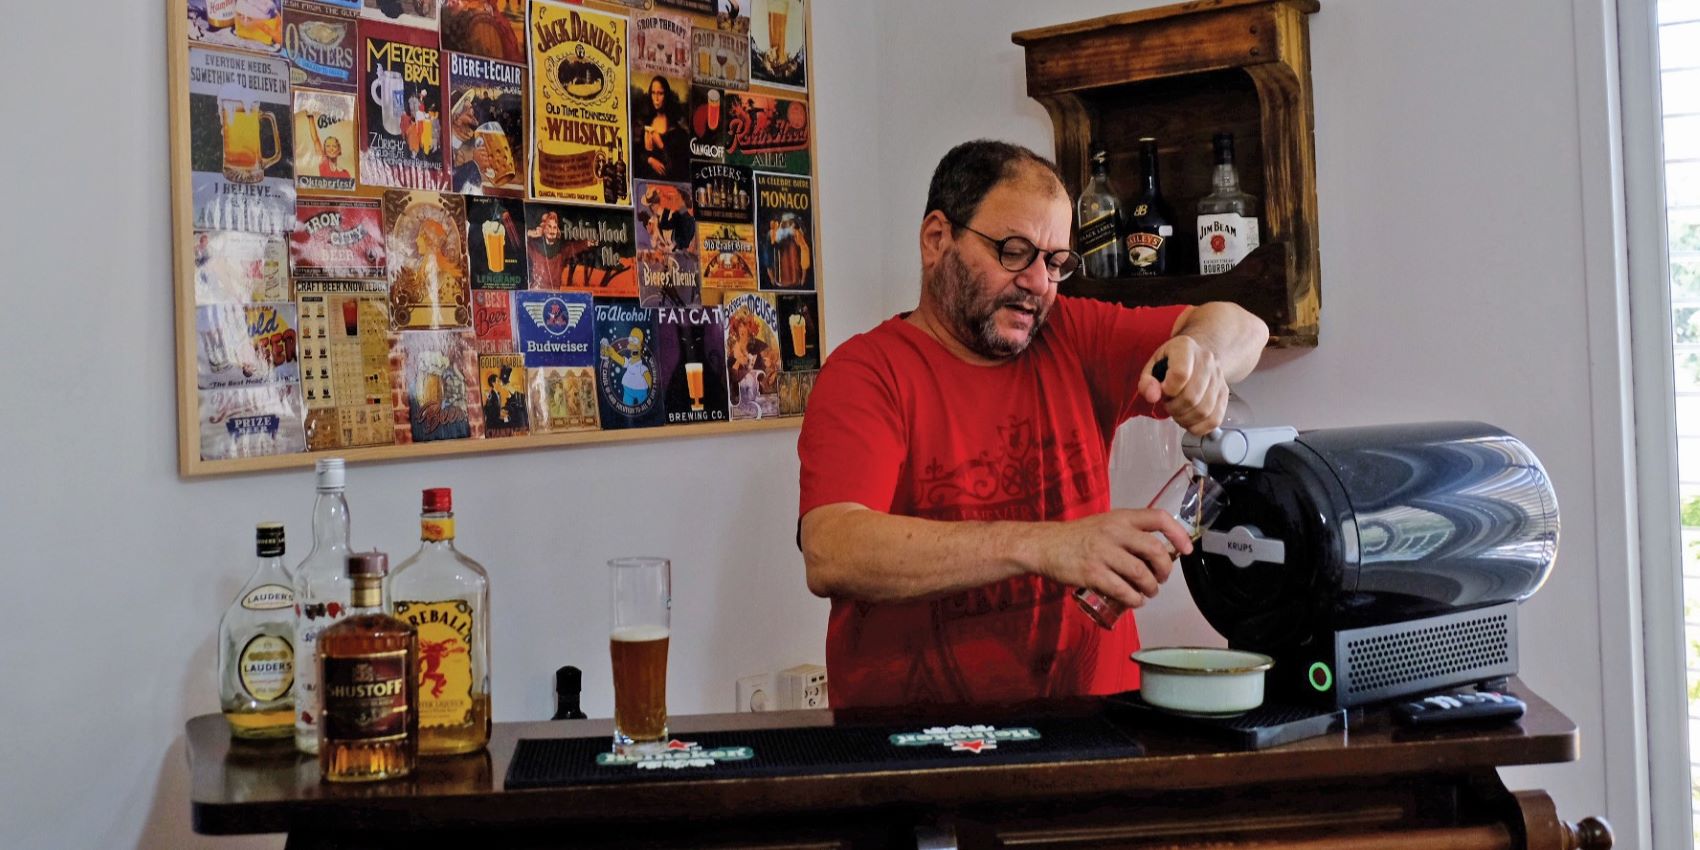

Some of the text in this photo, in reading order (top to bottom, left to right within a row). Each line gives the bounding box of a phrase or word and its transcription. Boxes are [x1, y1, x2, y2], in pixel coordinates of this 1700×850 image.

[534, 17, 570, 53] JACK
[636, 17, 686, 40] GROUP THERAPY
[286, 23, 354, 69] OYSTERS
[367, 38, 440, 74] METZGER
[205, 54, 245, 70] EVERYONE
[238, 72, 247, 88] TO
[248, 75, 277, 93] BELIEVE
[279, 79, 287, 94] IN
[405, 62, 440, 87] BRÄU
[545, 102, 618, 124] OLD TIME TENNESSEE
[546, 117, 621, 149] WHISKEY
[690, 137, 725, 159] GANGLOFF
[700, 164, 742, 183] CHEERS
[760, 191, 808, 209] MONACO
[304, 212, 342, 235] IRON
[563, 217, 627, 243] Robin Hood
[1199, 224, 1213, 240] JIM
[1212, 220, 1237, 237] BEAM
[601, 246, 622, 267] Ale
[296, 281, 320, 292] CRAFT
[322, 281, 343, 292] BEER
[485, 291, 507, 308] BEST
[477, 308, 507, 337] Beer
[594, 304, 652, 323] To Alcohol!
[657, 307, 723, 326] FAT CAT
[747, 294, 778, 332] MEUSE
[527, 341, 589, 353] Budweiser
[234, 416, 272, 429] PRIZE
[668, 410, 726, 423] BREWING CO.
[1227, 541, 1253, 554] KRUPS
